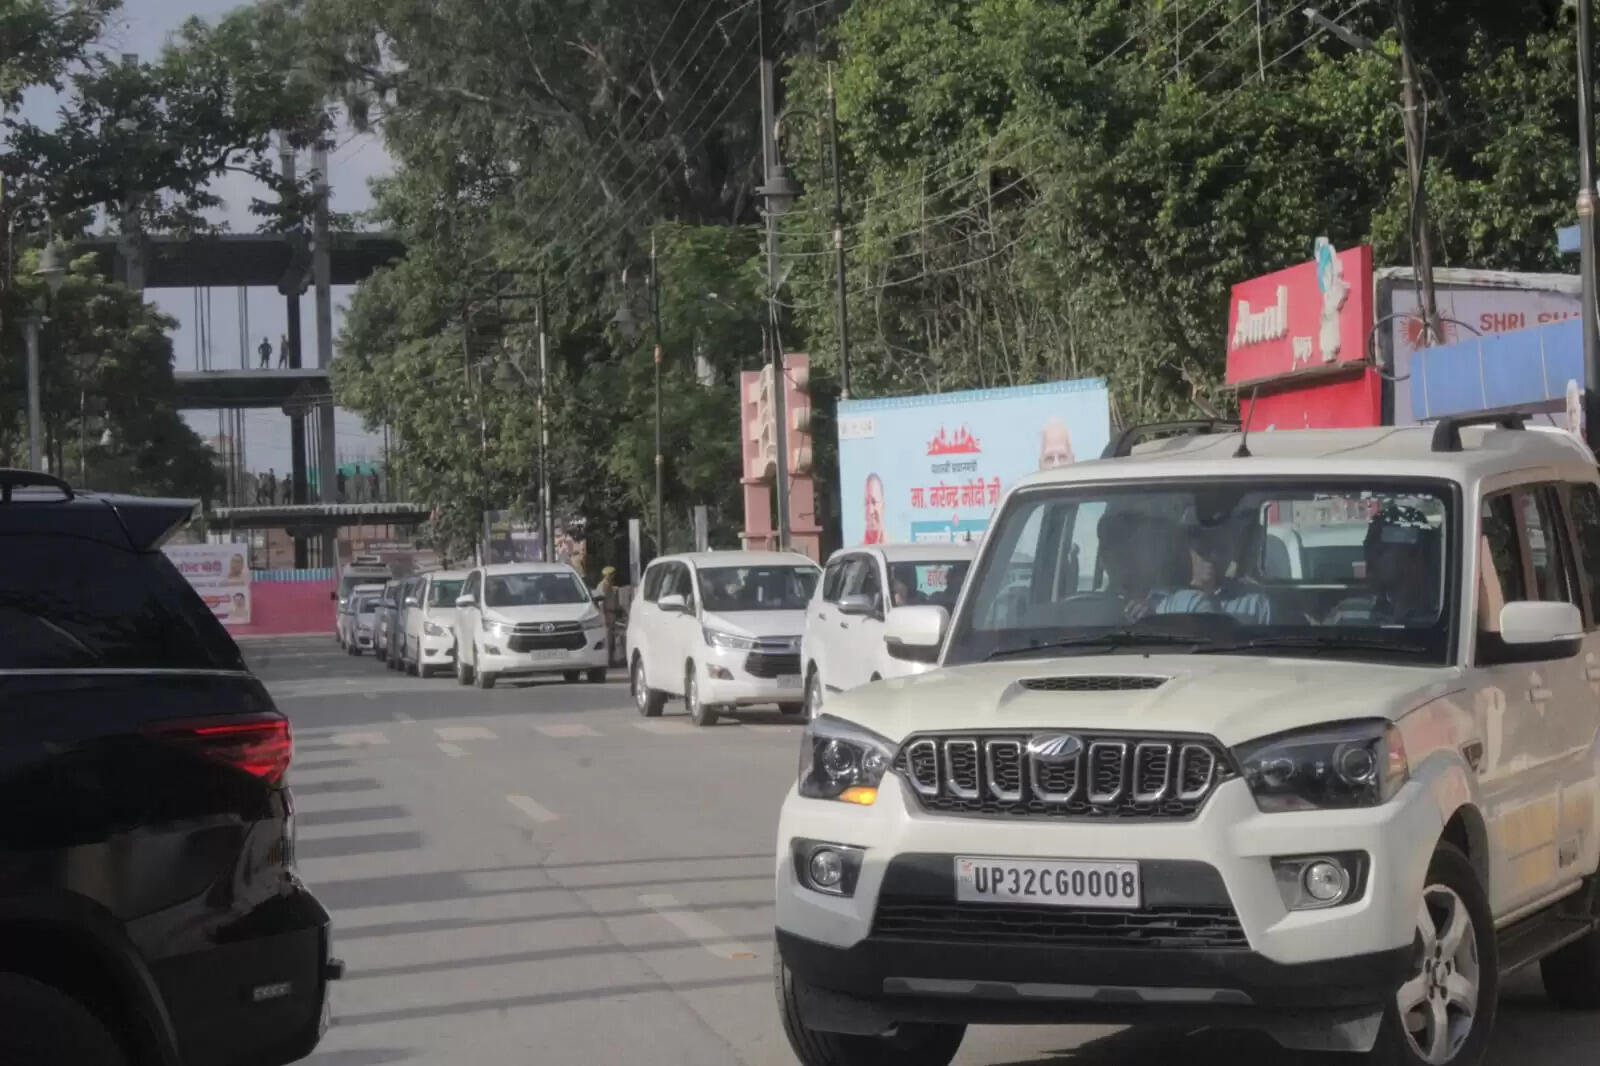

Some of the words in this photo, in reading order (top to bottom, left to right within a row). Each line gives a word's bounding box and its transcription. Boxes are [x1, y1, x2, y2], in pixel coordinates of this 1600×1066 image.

[1480, 311, 1525, 332] SHRI
[930, 480, 959, 508] नरेन्द्र
[961, 477, 985, 507] मोदी
[987, 476, 1001, 506] जी
[974, 866, 1136, 898] UP32CG0008
